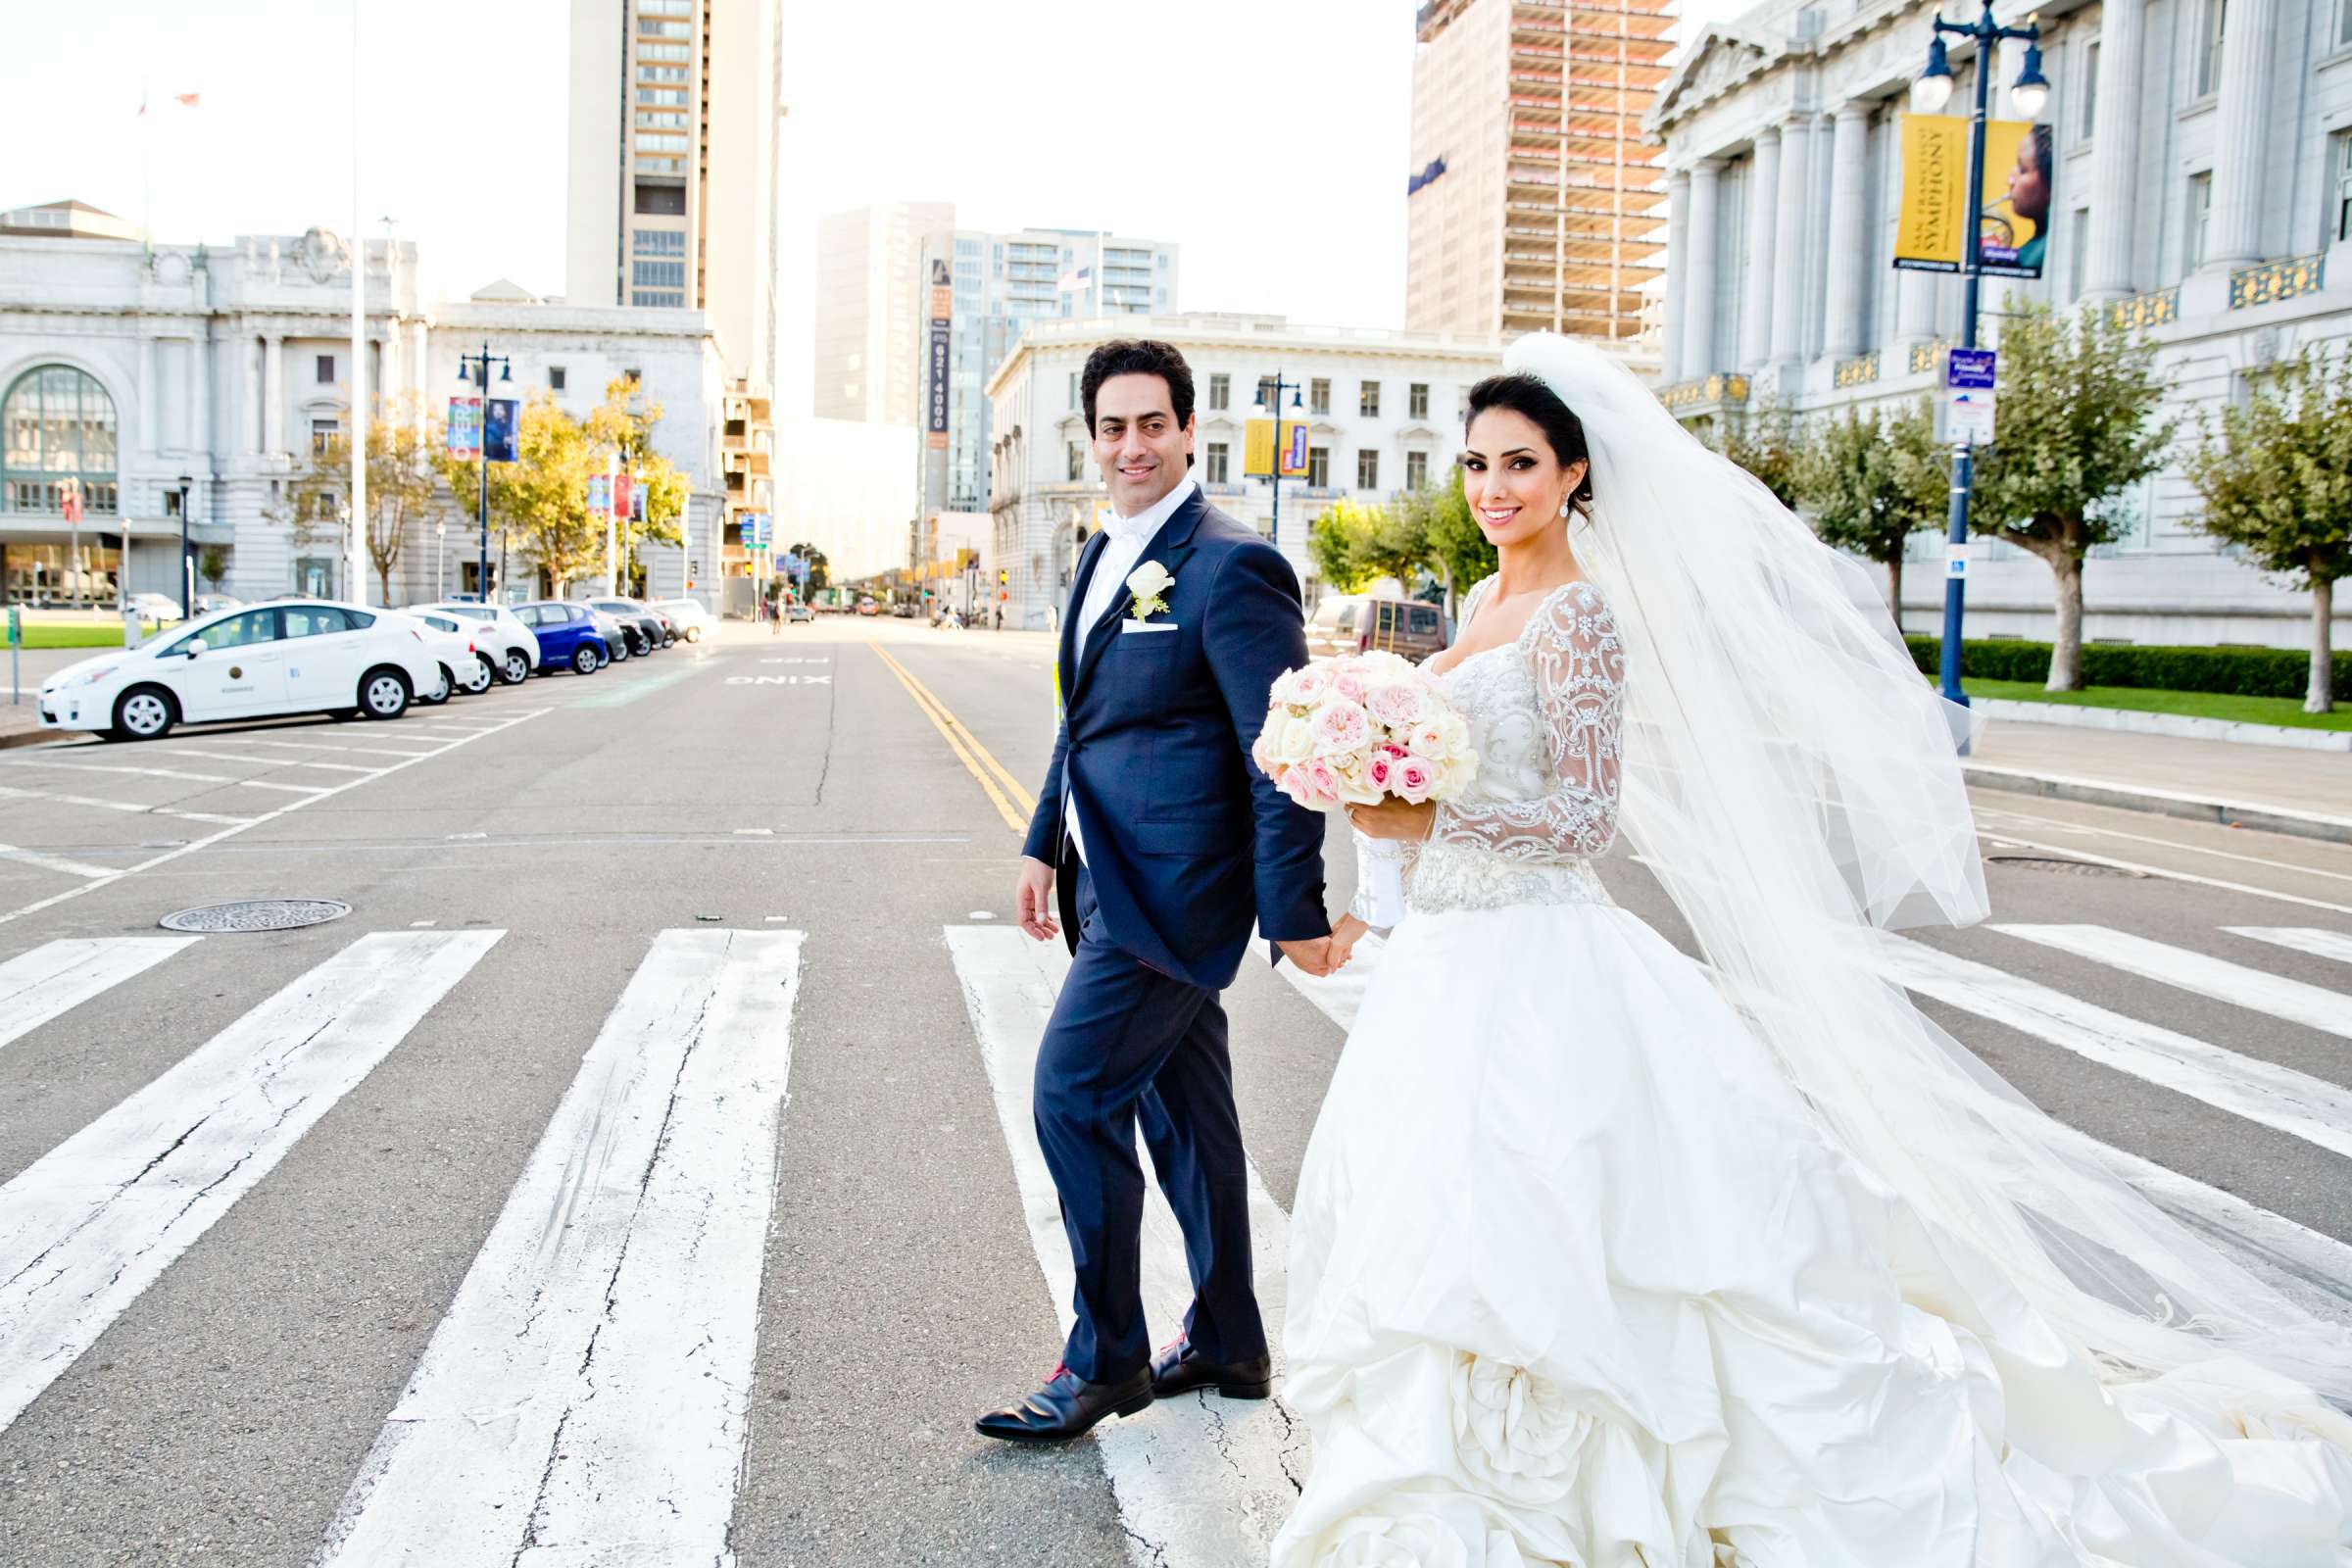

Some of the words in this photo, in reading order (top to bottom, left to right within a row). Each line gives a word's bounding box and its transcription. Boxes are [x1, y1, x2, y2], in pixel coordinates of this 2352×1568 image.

[1925, 130, 1943, 252] SYMPHONY
[454, 399, 471, 462] OPERA
[934, 381, 944, 428] 4000
